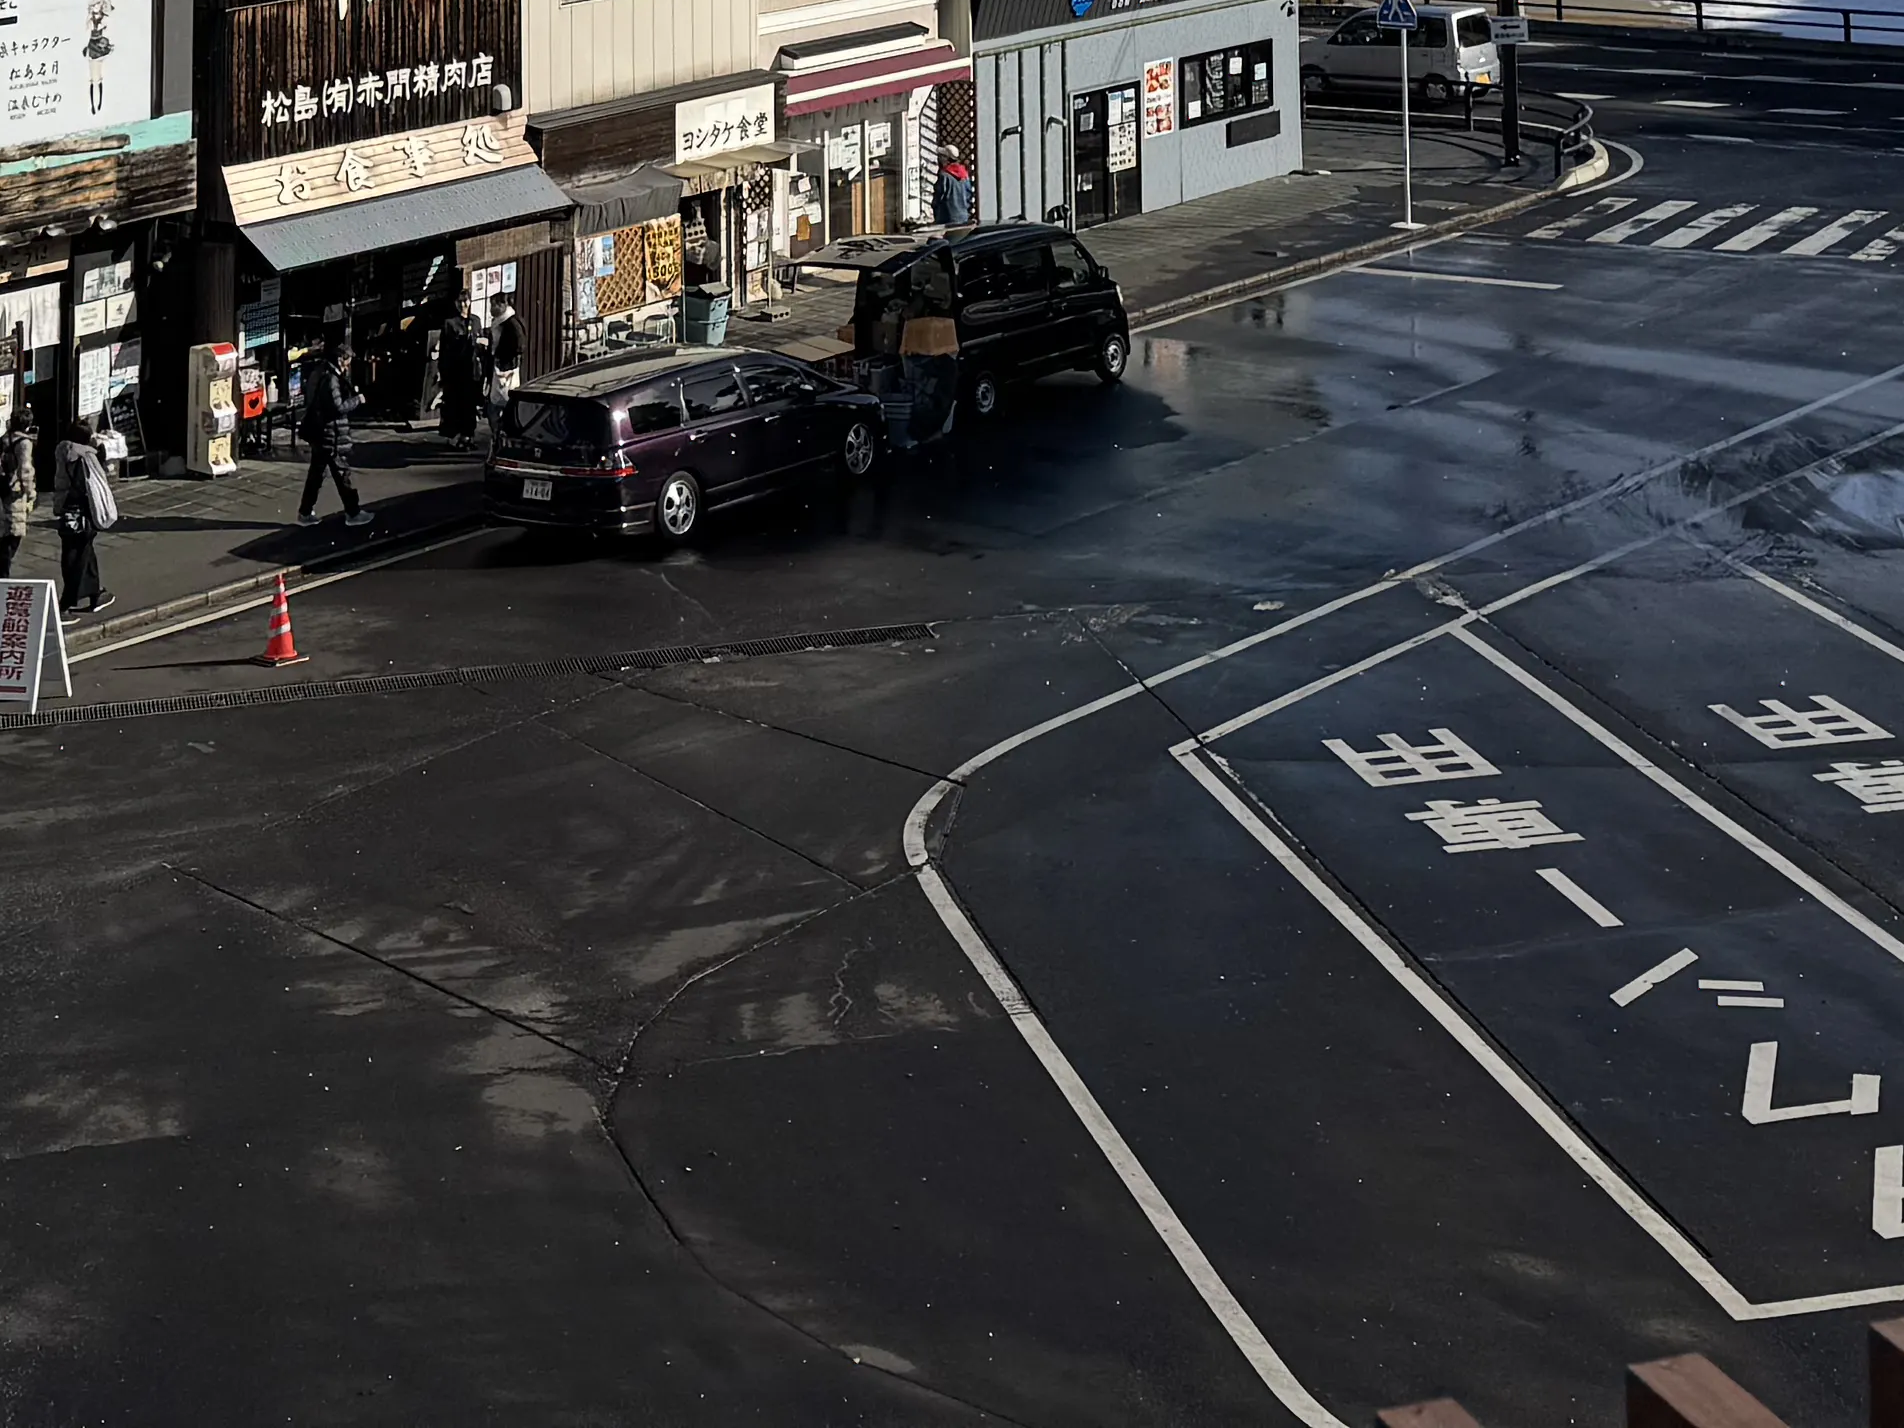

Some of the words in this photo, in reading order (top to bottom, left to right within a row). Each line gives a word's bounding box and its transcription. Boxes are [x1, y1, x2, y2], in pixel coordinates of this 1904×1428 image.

[683, 112, 769, 152] ヨシタケ食堂
[275, 124, 504, 205] お食事処
